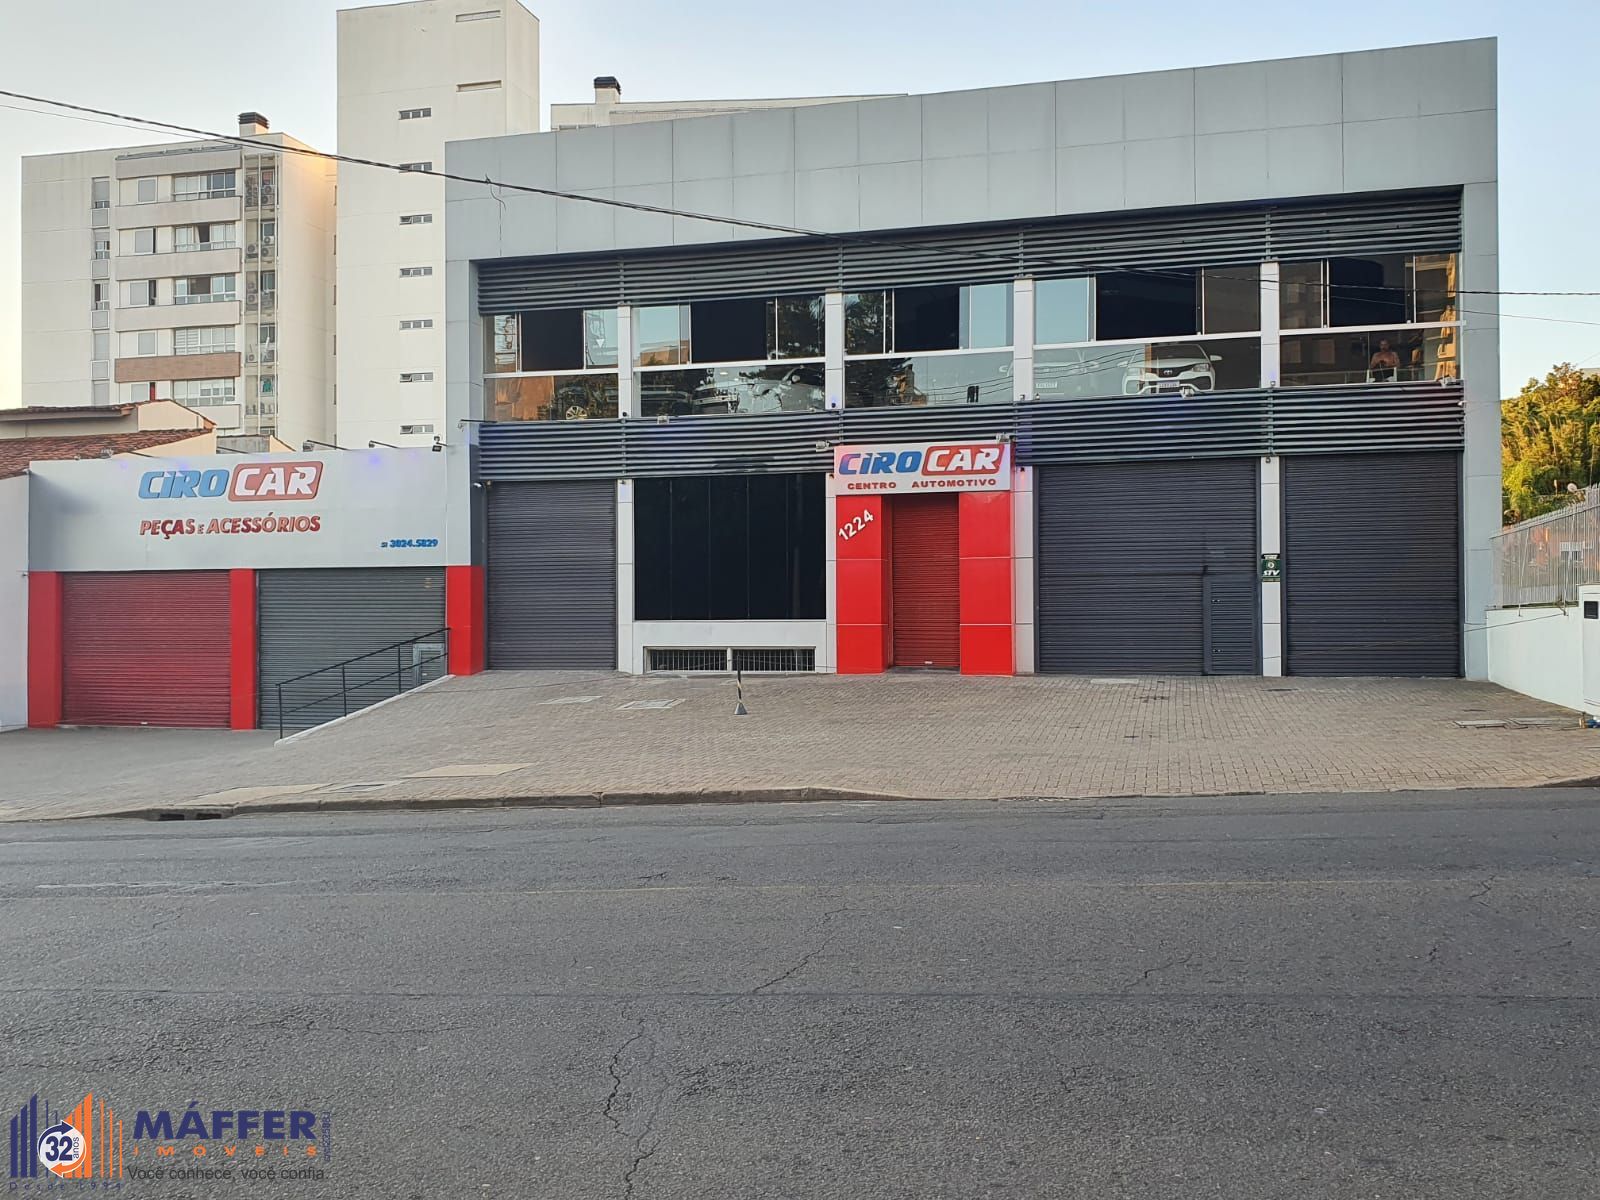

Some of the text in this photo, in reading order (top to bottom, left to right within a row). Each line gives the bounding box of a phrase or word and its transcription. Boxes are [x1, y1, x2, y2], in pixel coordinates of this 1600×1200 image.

[838, 448, 1000, 475] CIRO CAR
[138, 466, 317, 499] CIRO CAR
[847, 478, 996, 490] CENTRO AUTOMOTIVO
[139, 518, 196, 539] PEÇAS
[206, 511, 321, 535] ACESSÓRIOS
[838, 508, 874, 541] 1224
